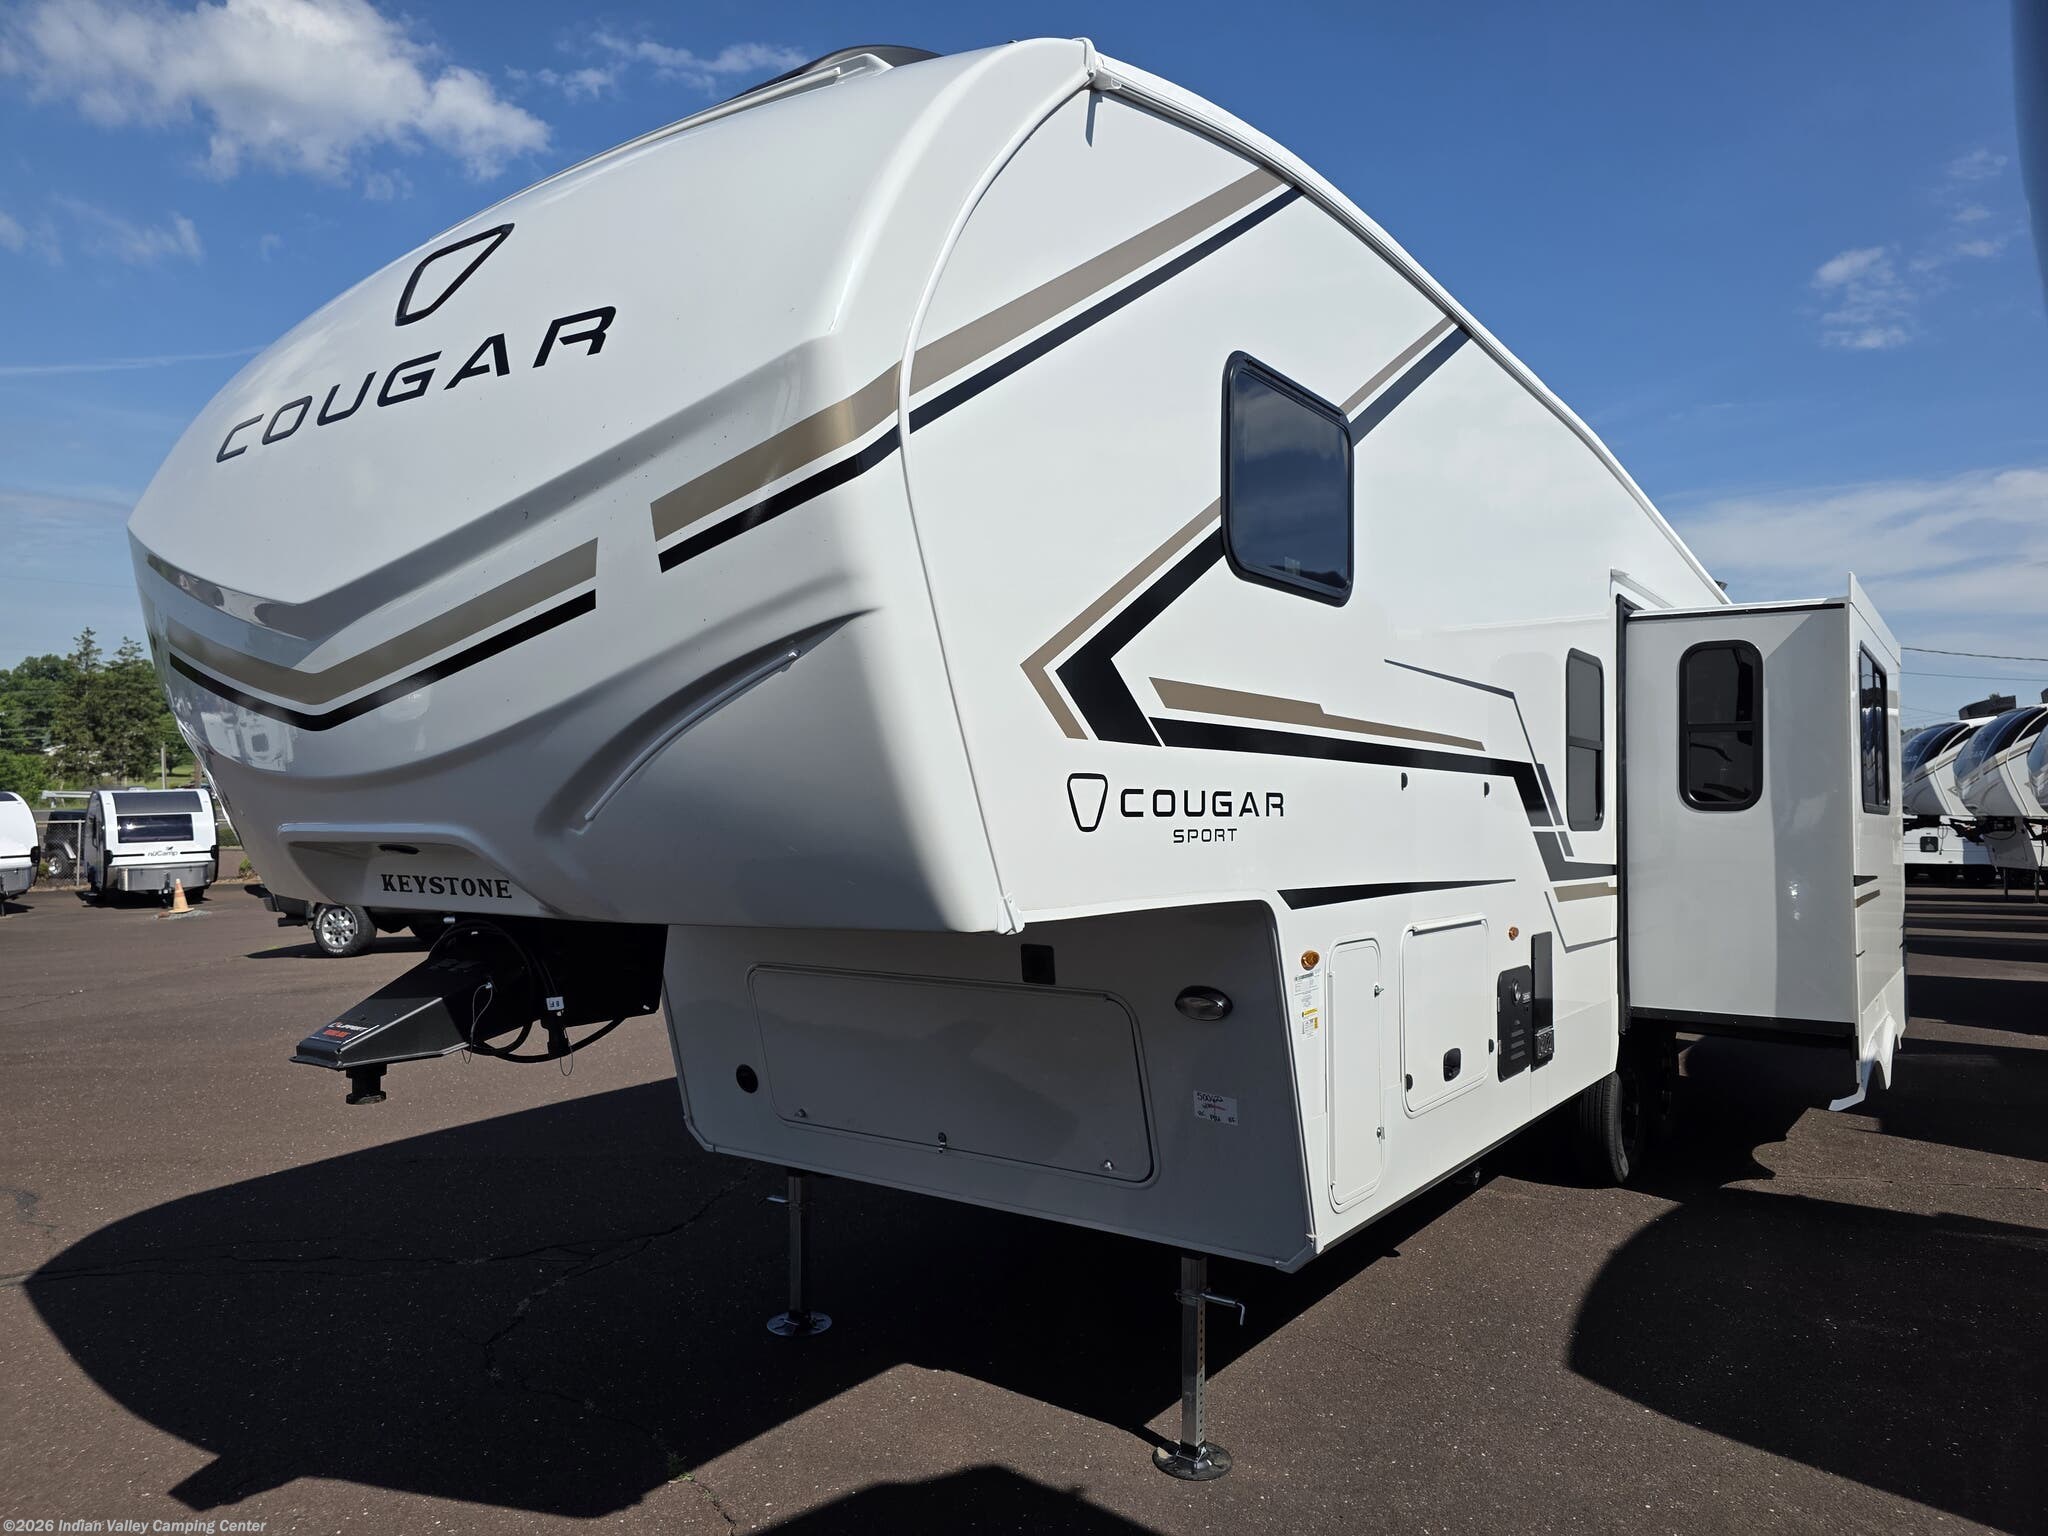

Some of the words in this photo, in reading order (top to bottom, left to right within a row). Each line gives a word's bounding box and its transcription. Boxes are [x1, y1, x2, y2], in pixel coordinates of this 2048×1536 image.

[216, 305, 617, 463] COUGAR
[1120, 788, 1284, 818] COUGAR
[1173, 828, 1238, 844] SPORT
[381, 873, 513, 899] KEYSTONE
